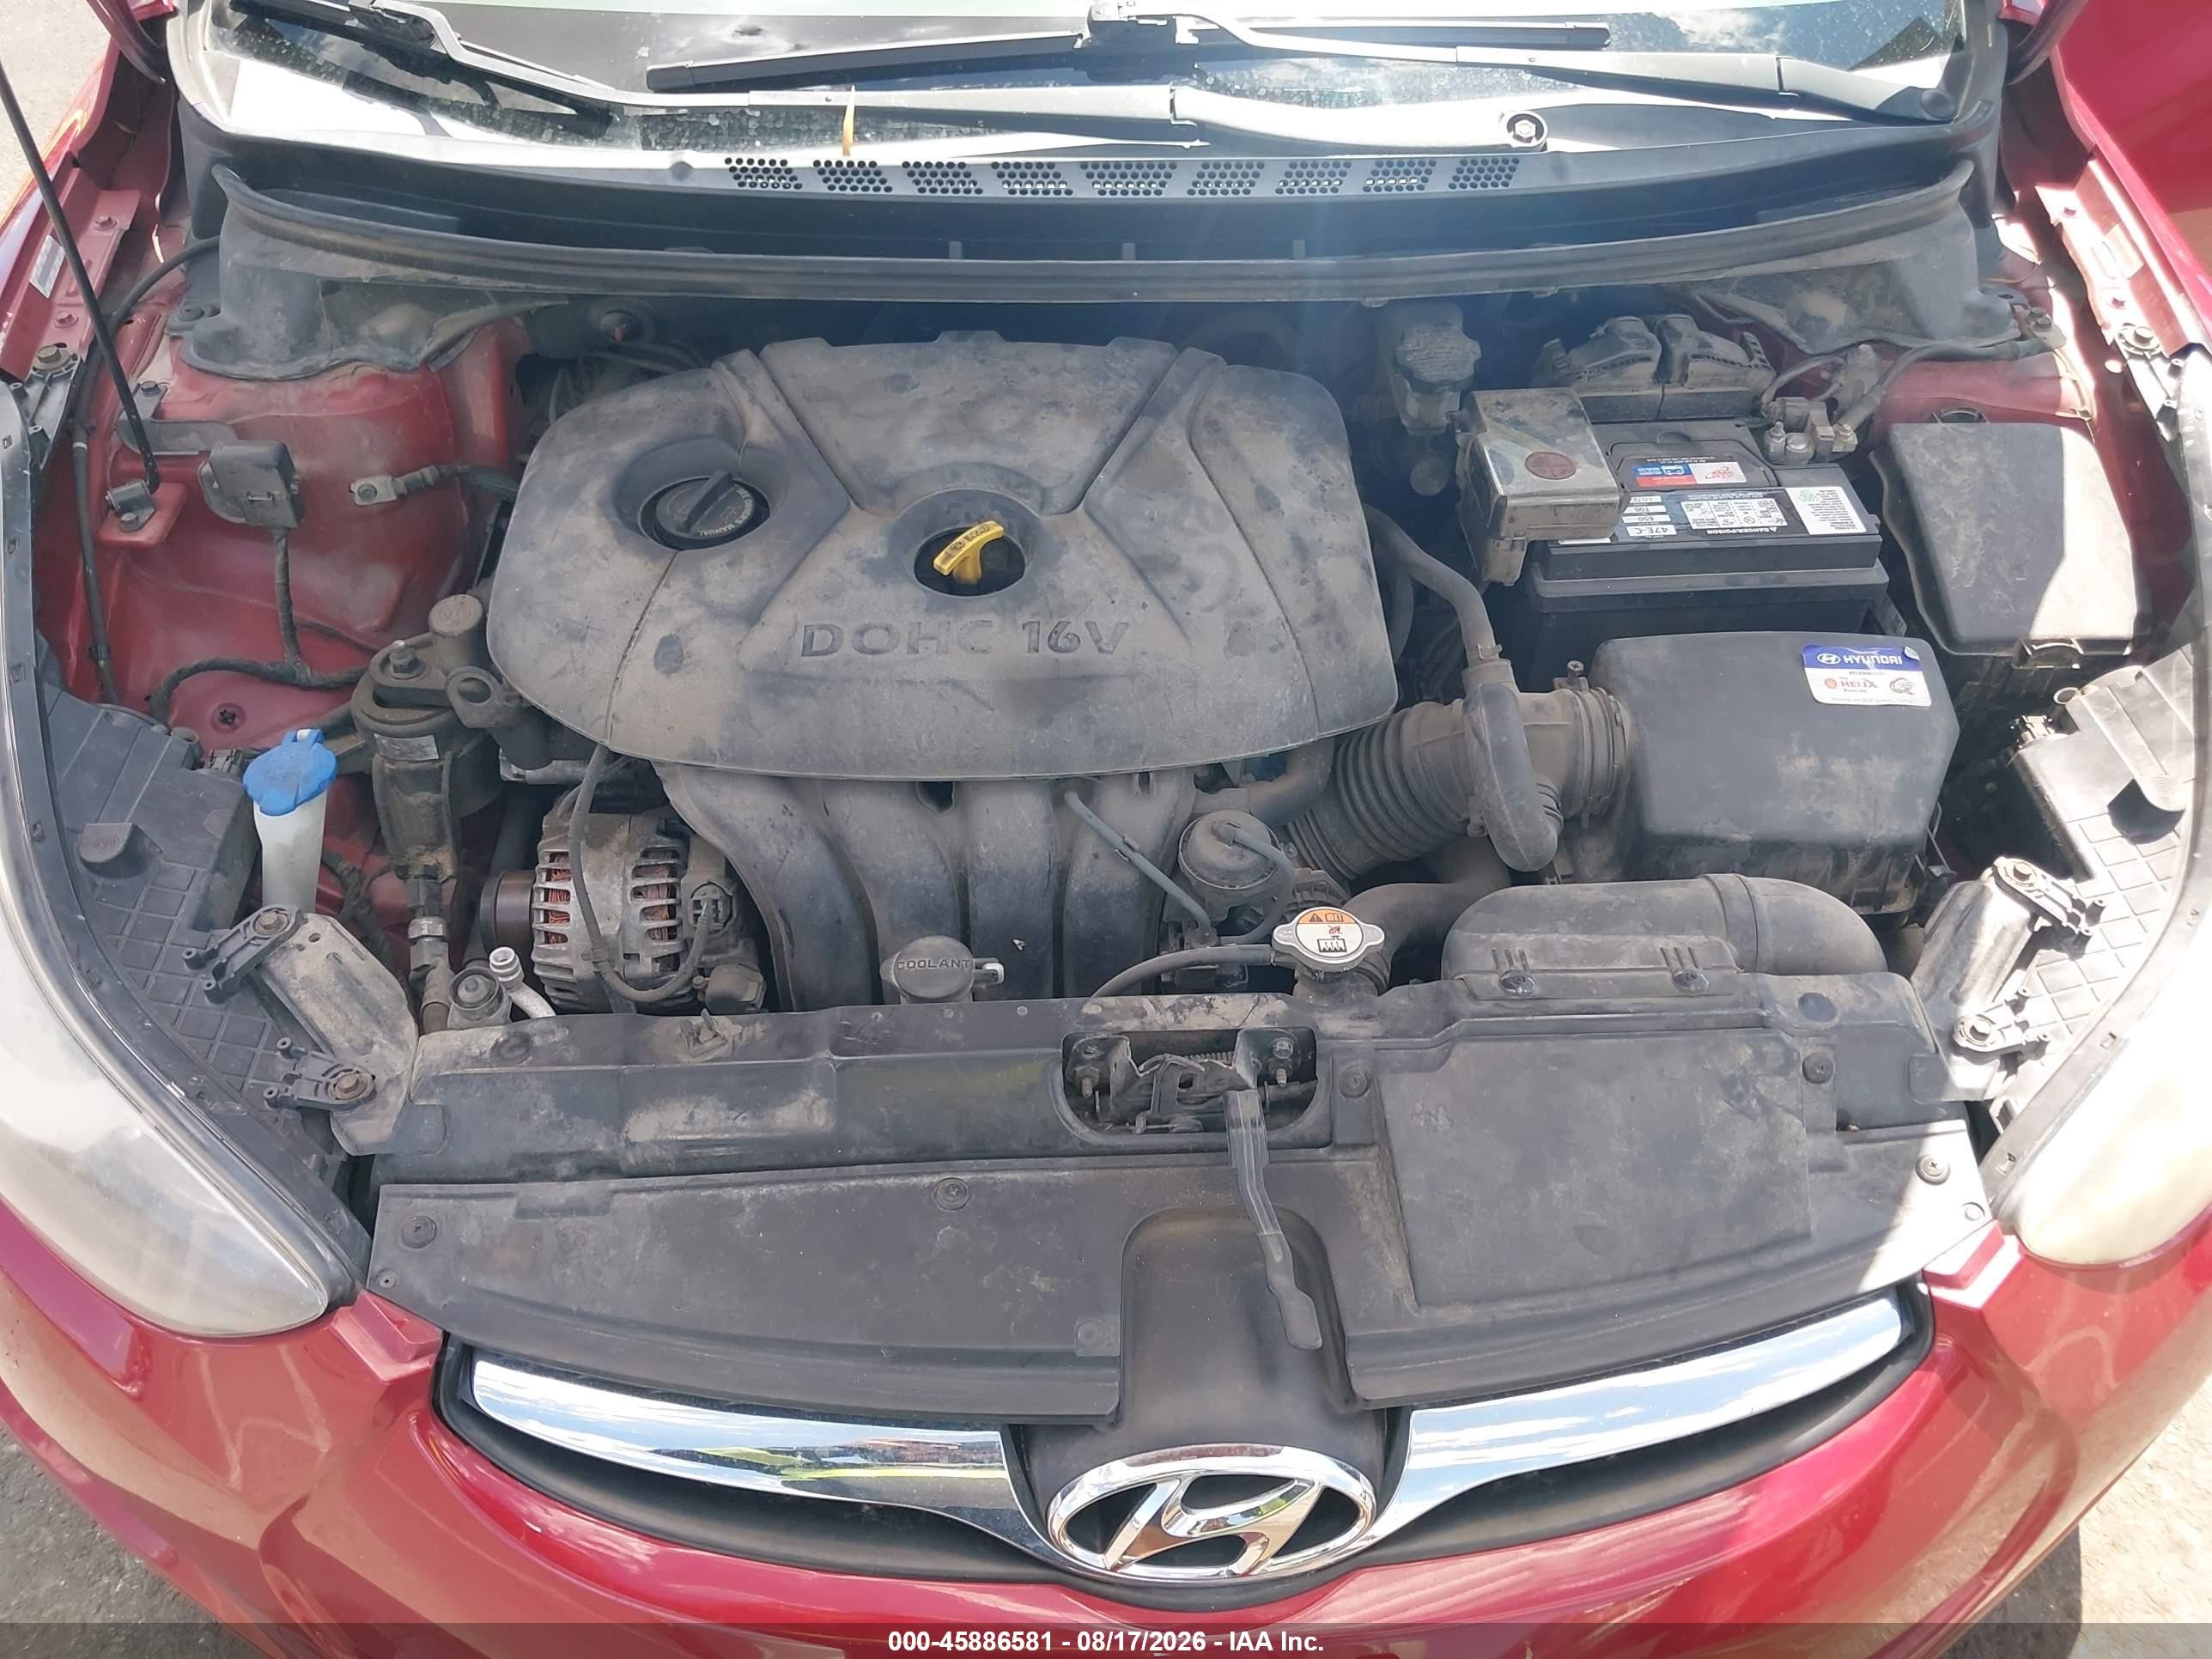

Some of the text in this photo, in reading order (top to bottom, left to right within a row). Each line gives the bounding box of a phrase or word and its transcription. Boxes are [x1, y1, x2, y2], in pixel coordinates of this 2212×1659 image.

[801, 620, 1130, 657] DOHC 16V
[1843, 654, 1903, 665] HYUNDAI
[1841, 679, 1879, 689] HELIX
[896, 958, 970, 969] COOLANT
